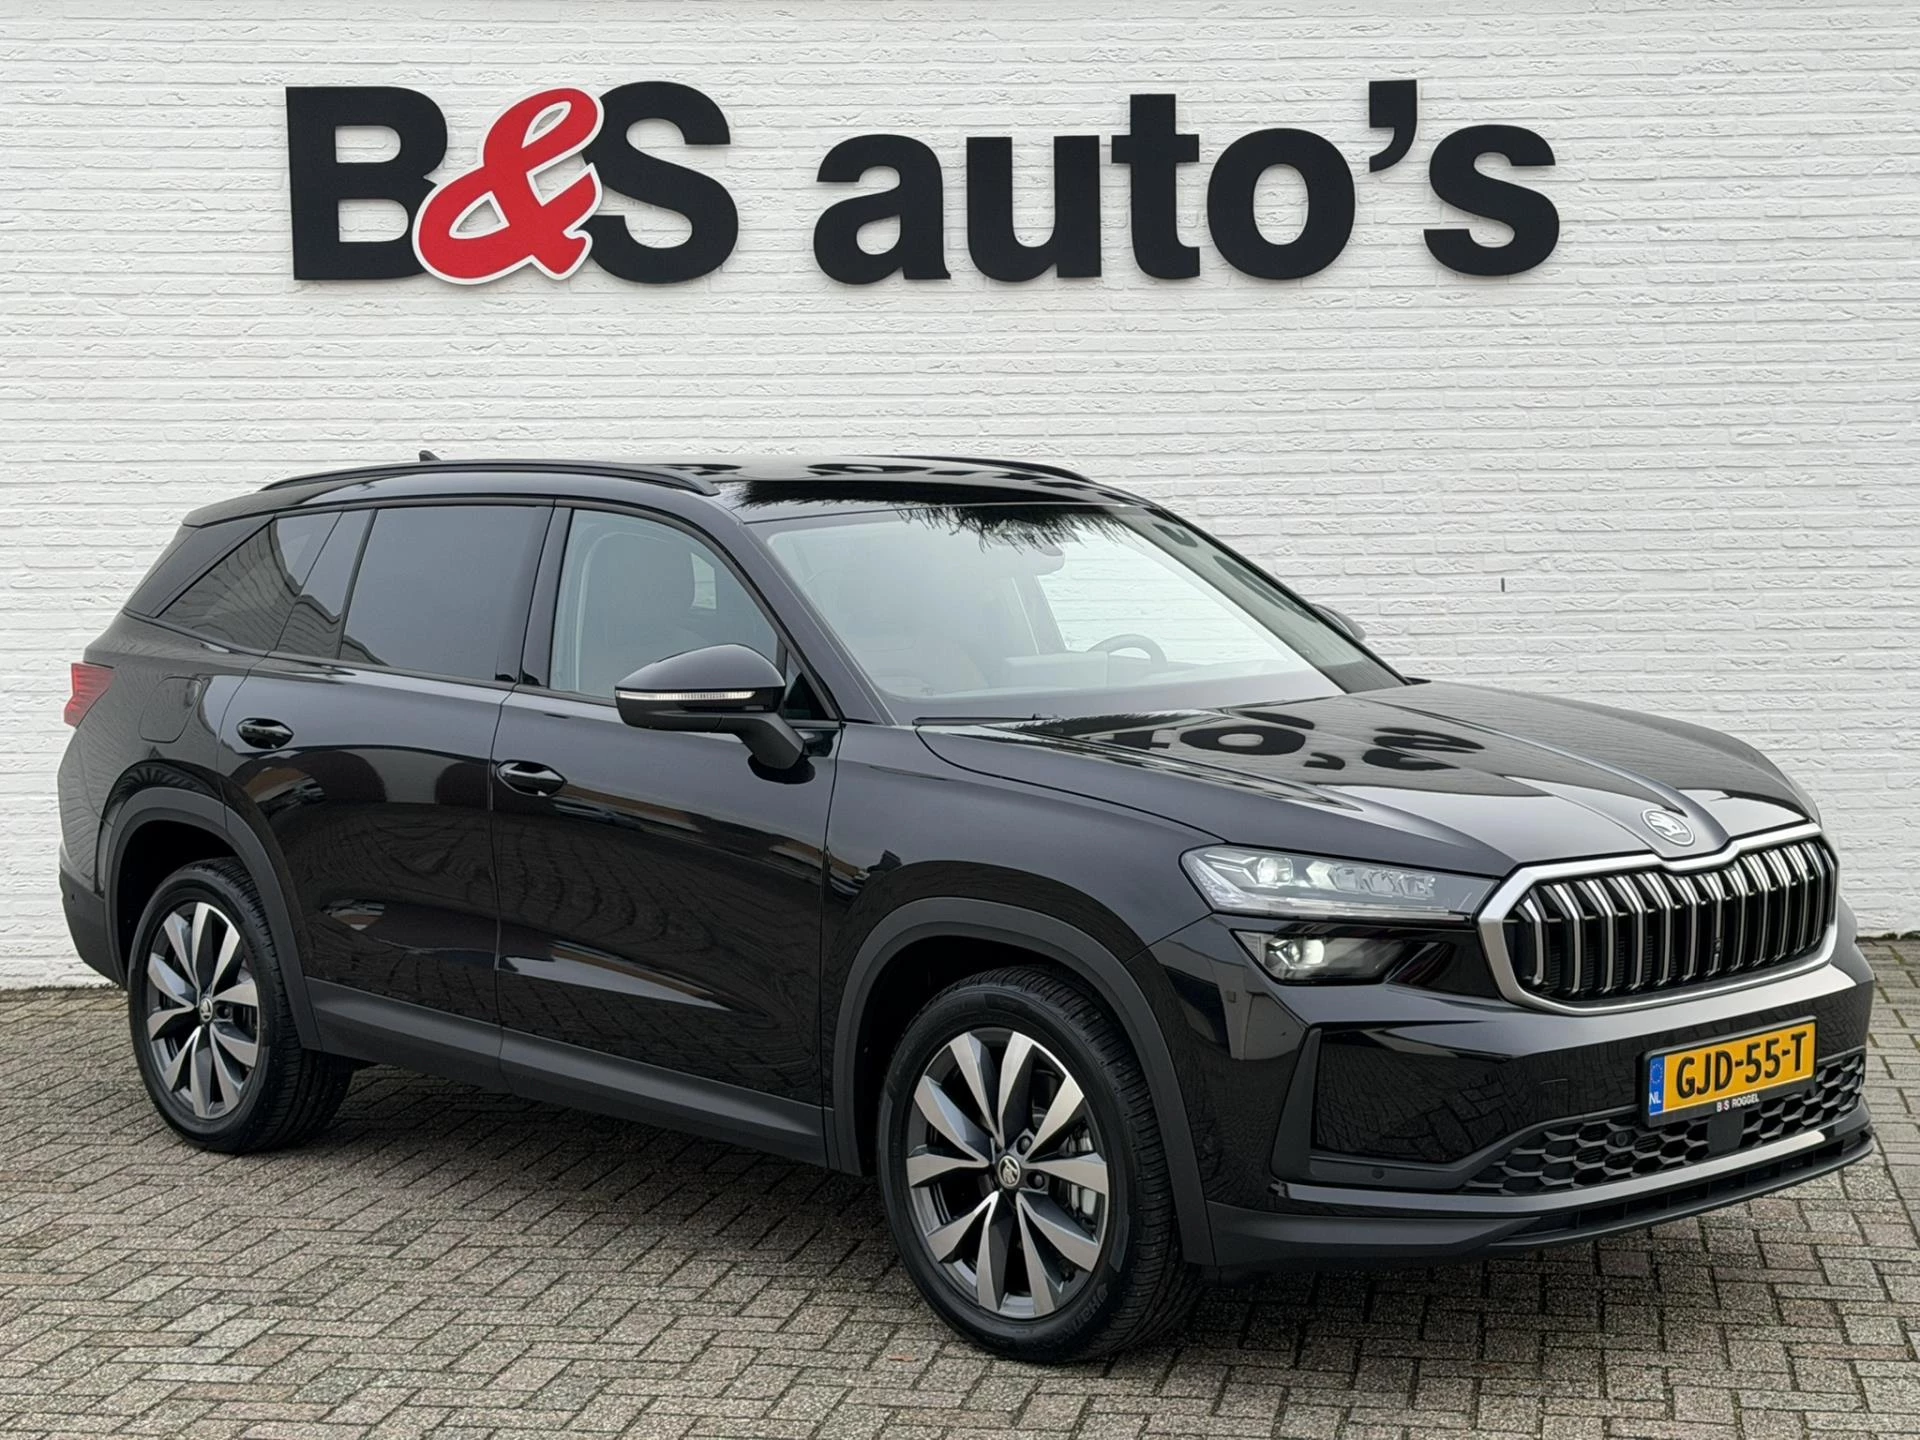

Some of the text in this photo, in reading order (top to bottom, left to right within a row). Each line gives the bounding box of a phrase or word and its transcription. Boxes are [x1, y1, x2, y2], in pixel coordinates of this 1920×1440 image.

[285, 79, 1560, 285] B&S auto's
[1648, 1091, 1662, 1105] NL
[1676, 1031, 1808, 1100] GJD-55-T
